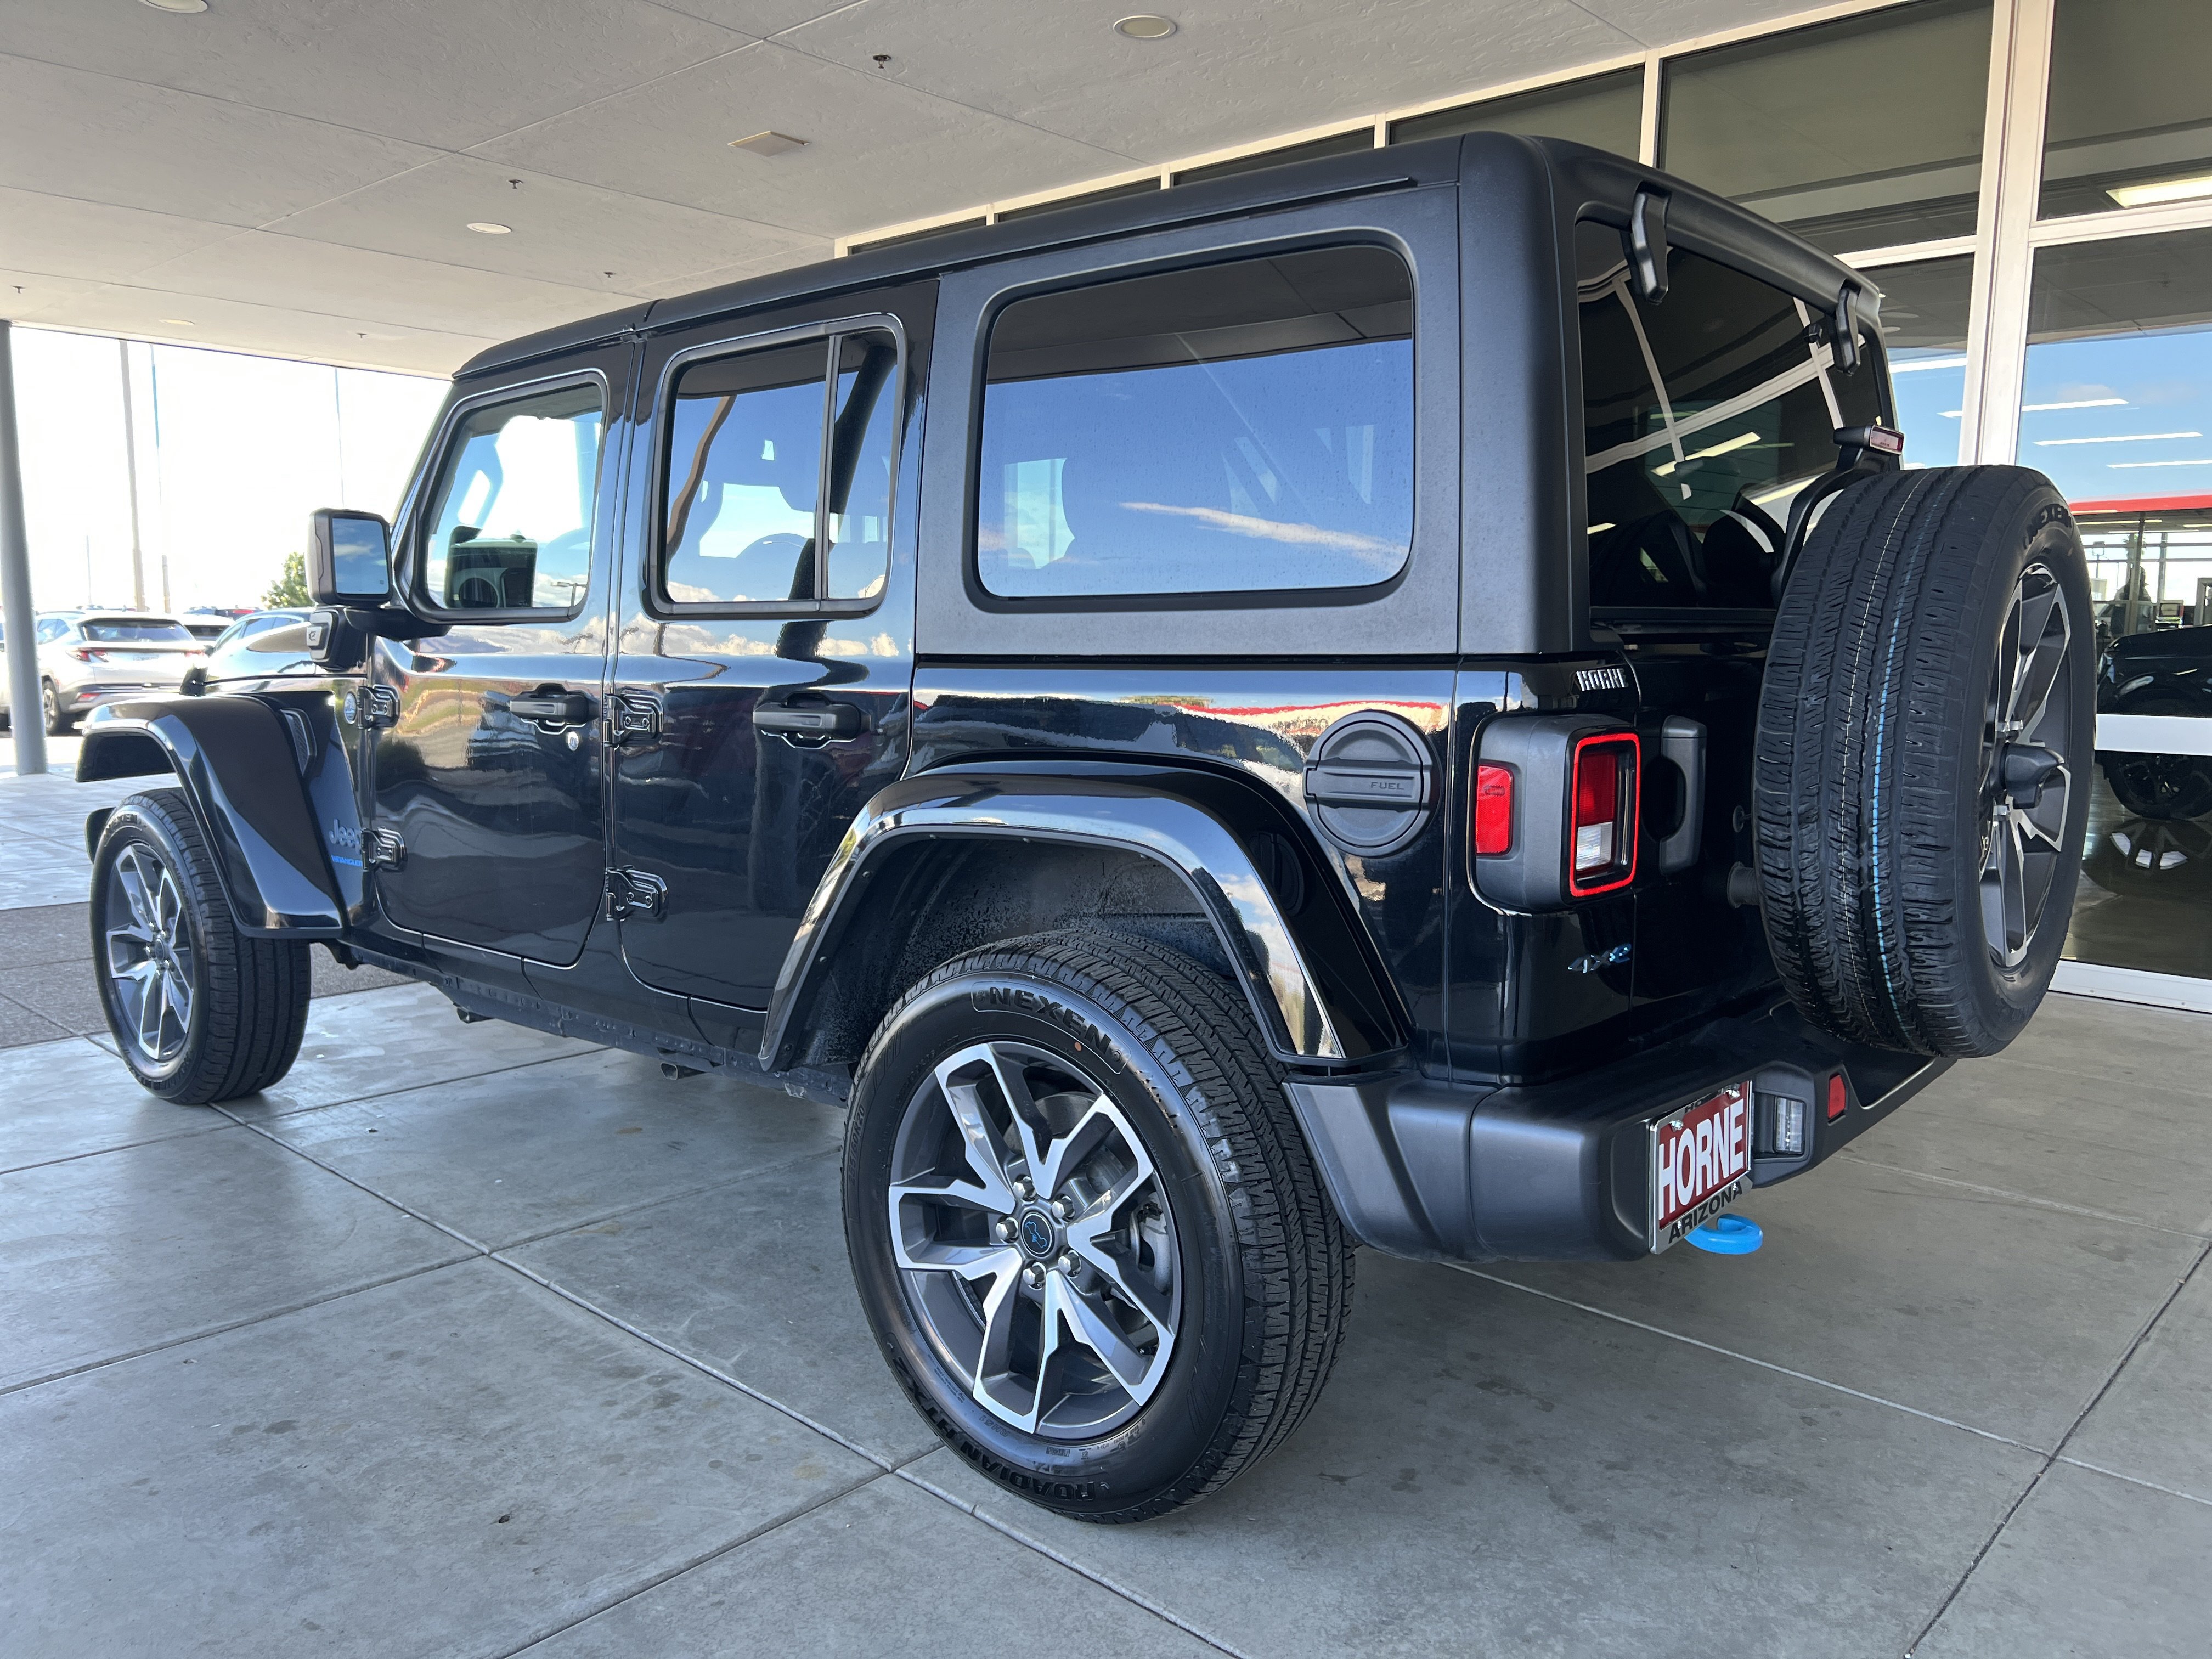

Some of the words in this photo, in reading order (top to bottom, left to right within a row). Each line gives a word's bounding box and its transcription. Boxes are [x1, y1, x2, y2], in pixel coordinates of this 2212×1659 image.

[1576, 668, 1629, 691] HORNE
[1371, 782, 1405, 791] FUEL
[329, 819, 360, 855] Jeep
[989, 987, 1111, 1055] NEXEN
[1658, 1098, 1743, 1221] HORNE
[1668, 1180, 1743, 1244] ARIZONA
[961, 1441, 1096, 1501] ROADIAN
